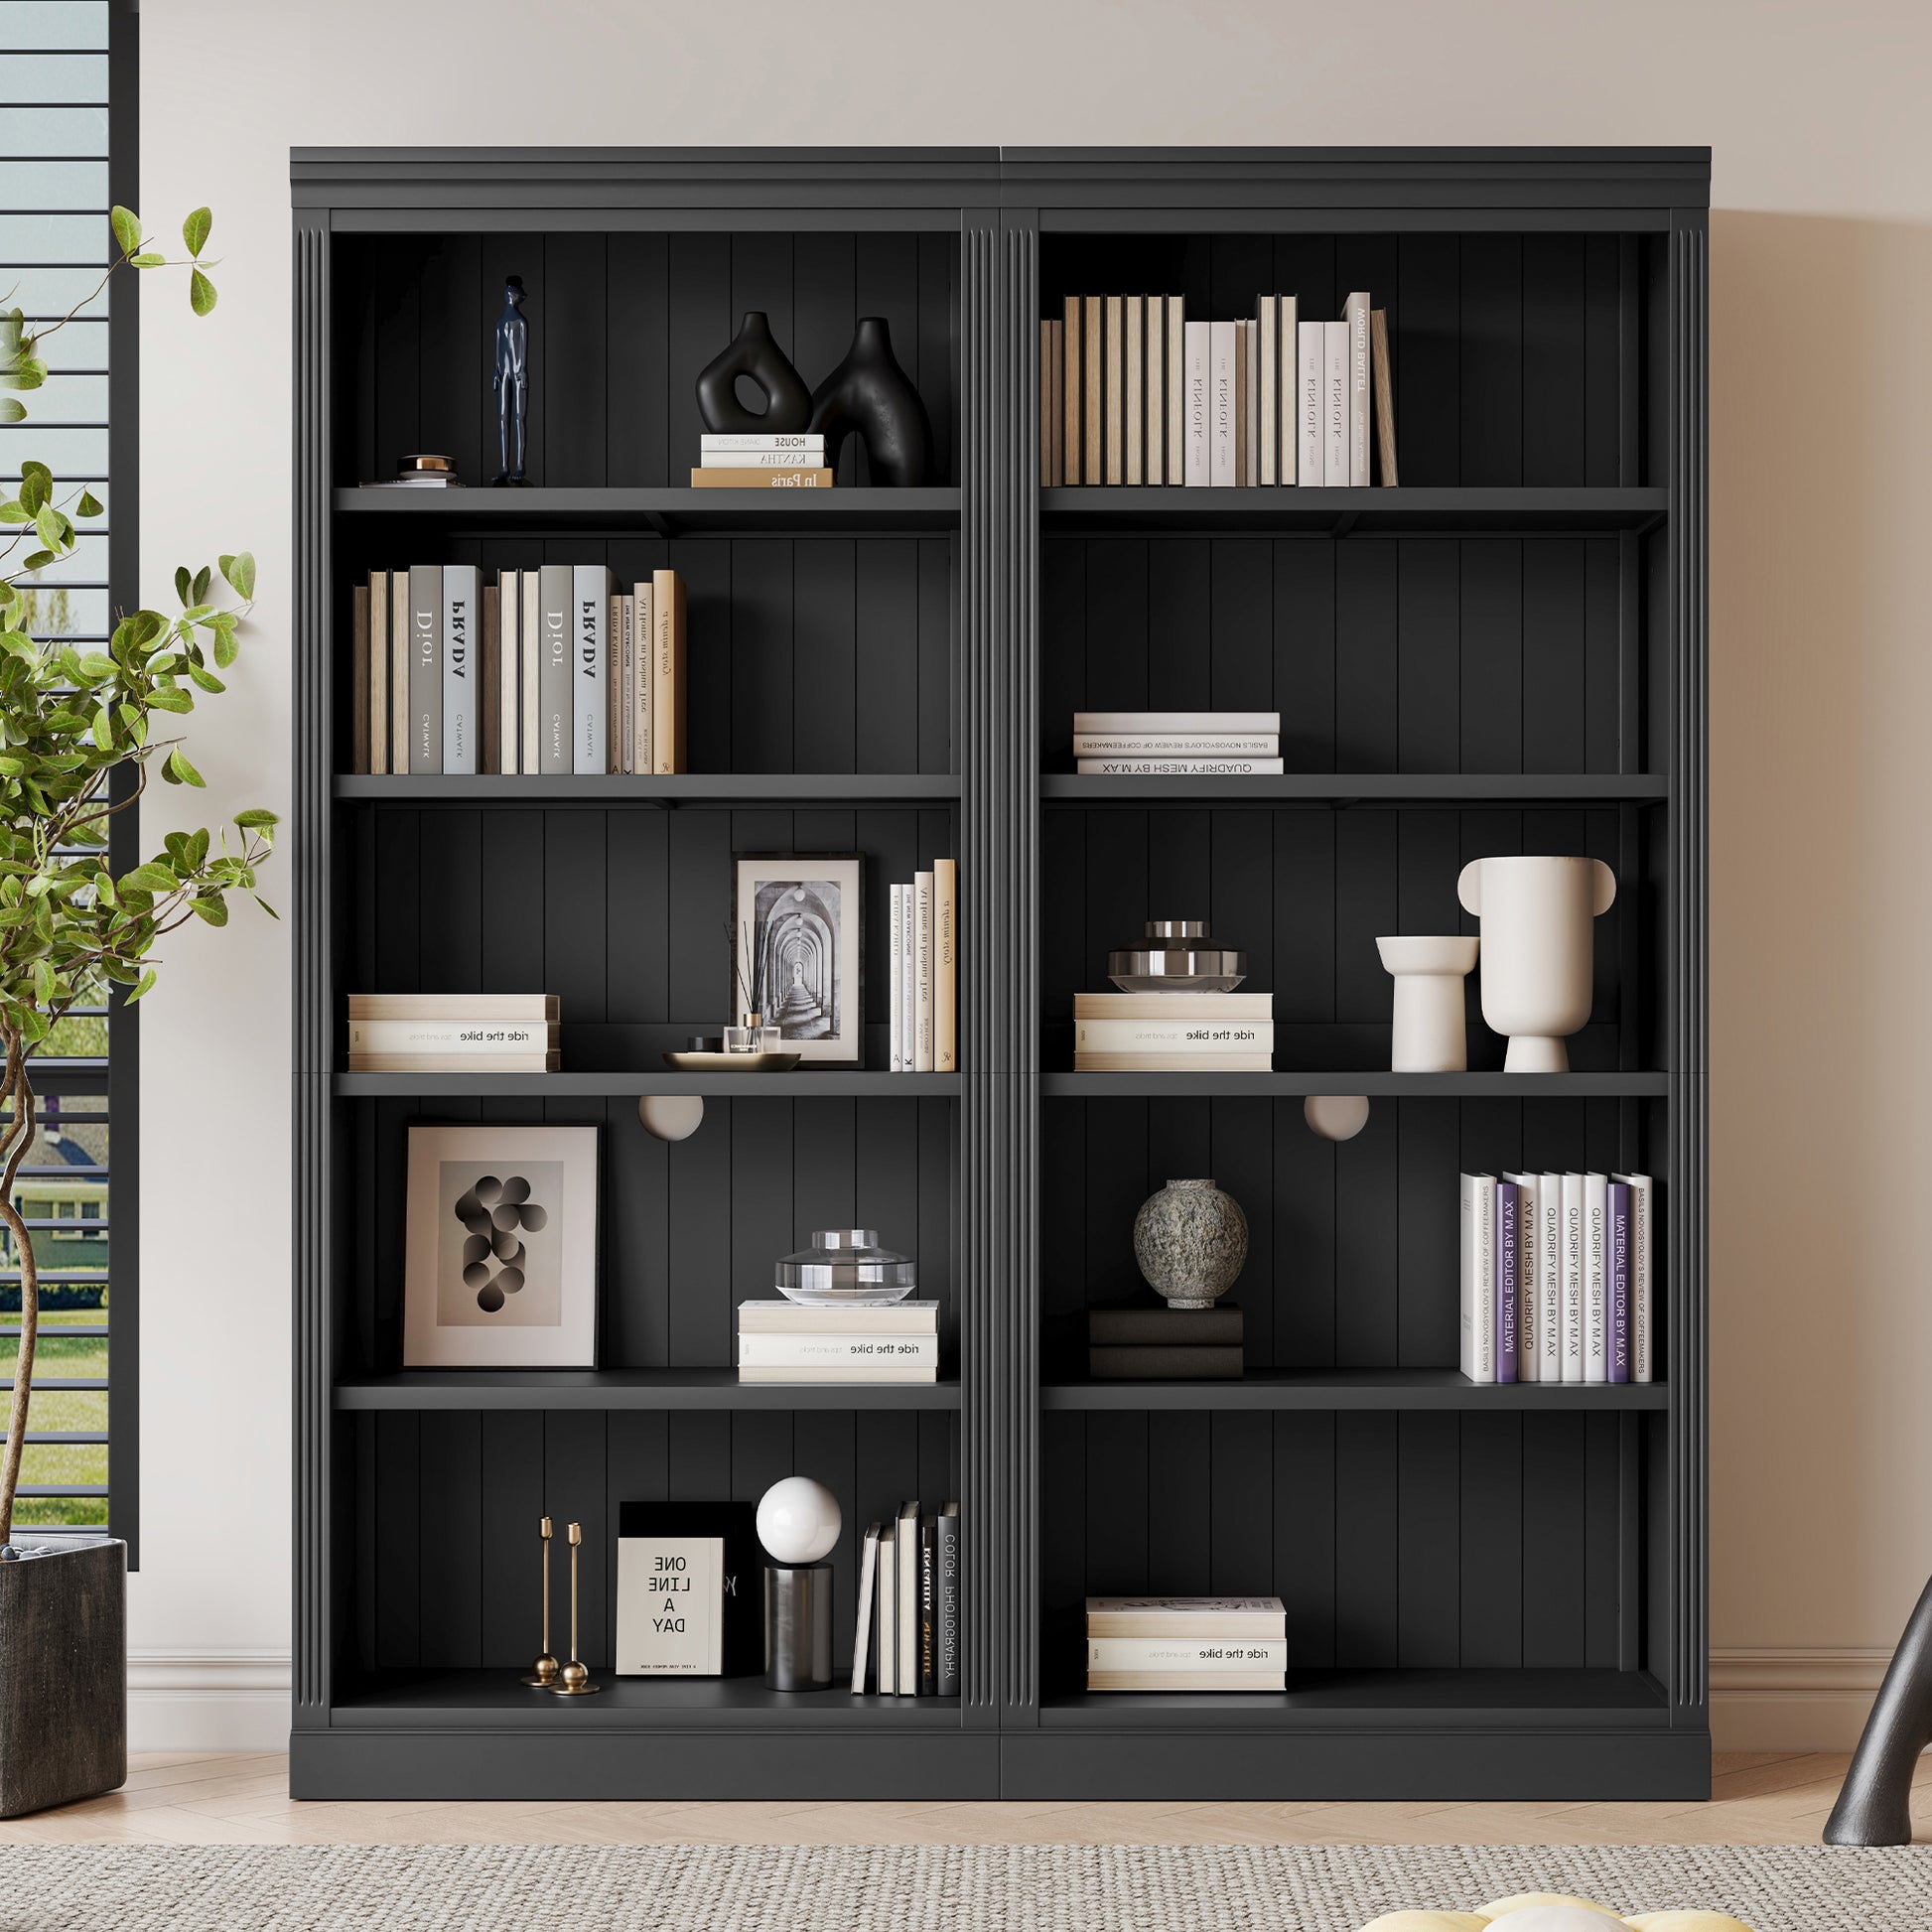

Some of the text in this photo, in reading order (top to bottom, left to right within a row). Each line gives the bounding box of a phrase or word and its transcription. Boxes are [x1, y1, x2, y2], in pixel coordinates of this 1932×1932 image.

[1191, 763, 1251, 772] QUADRIFY
[1525, 1233, 1533, 1249] BY
[1483, 1247, 1488, 1257] OF
[1505, 1201, 1514, 1352] MATERIAL EDITOR BY M.AX
[1547, 1207, 1557, 1356] QUADRIFY MESH BY M.AX
[1570, 1207, 1579, 1356] QUADRIFY MESH BY M.AX
[1616, 1215, 1625, 1366] MATERIAL EDITOR BY M.AX
[1639, 1303, 1644, 1312] OF
[1592, 1310, 1600, 1324] BY
